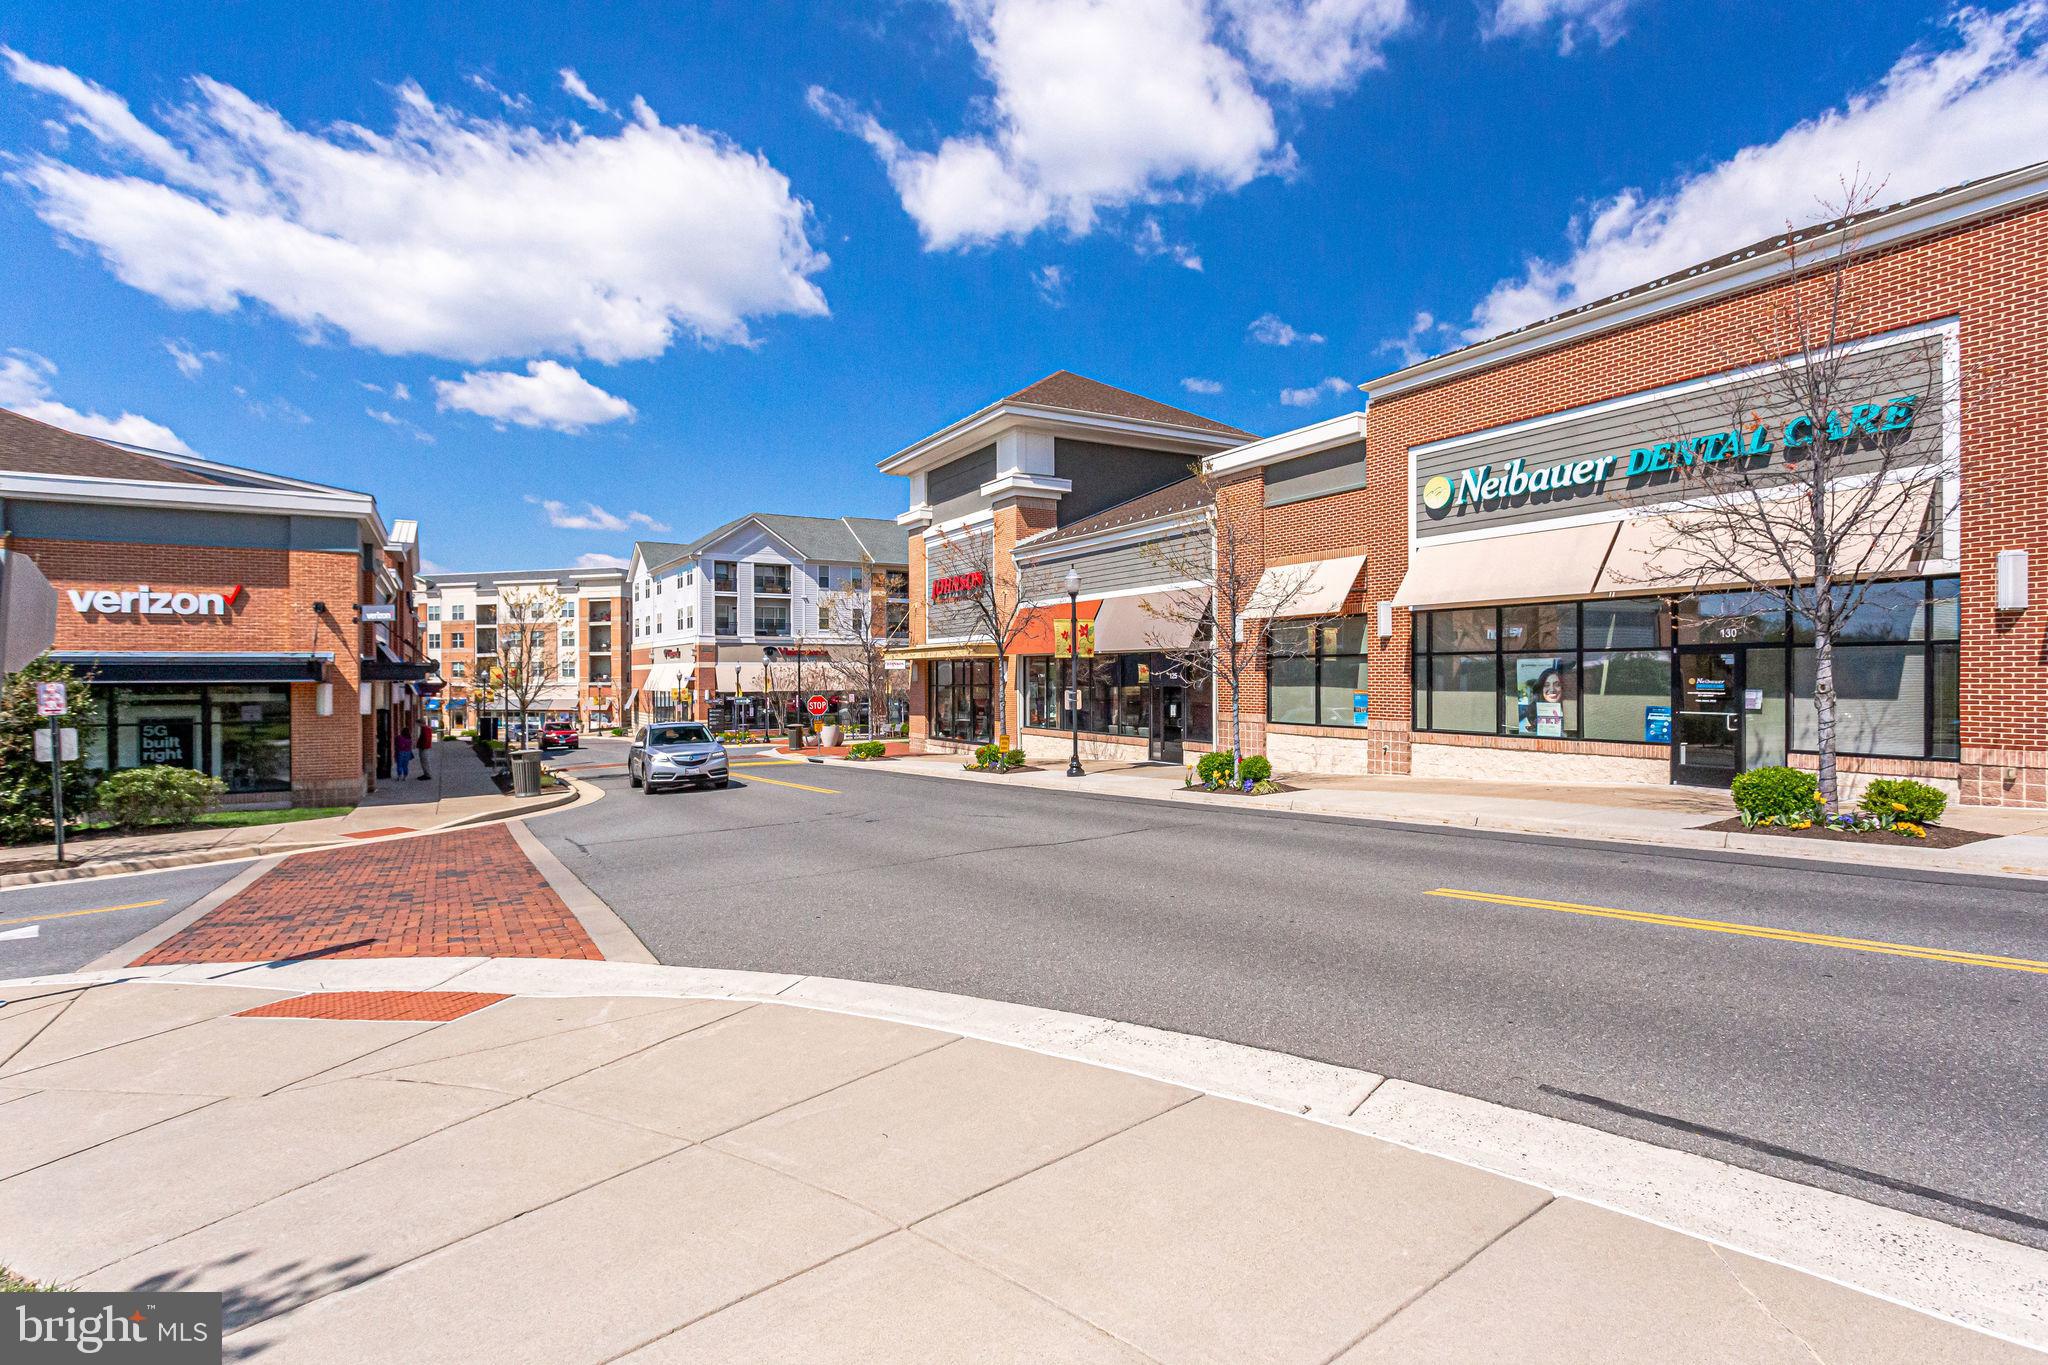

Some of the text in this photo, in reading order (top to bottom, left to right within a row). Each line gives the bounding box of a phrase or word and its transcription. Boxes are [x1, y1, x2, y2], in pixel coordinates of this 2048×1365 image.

[1454, 395, 1919, 505] Neibauer DENTAL CARE
[67, 585, 224, 615] verizon
[1720, 628, 1738, 638] 130
[809, 701, 826, 710] STOP
[142, 724, 168, 737] 5G
[142, 736, 181, 749] built
[142, 748, 183, 763] right
